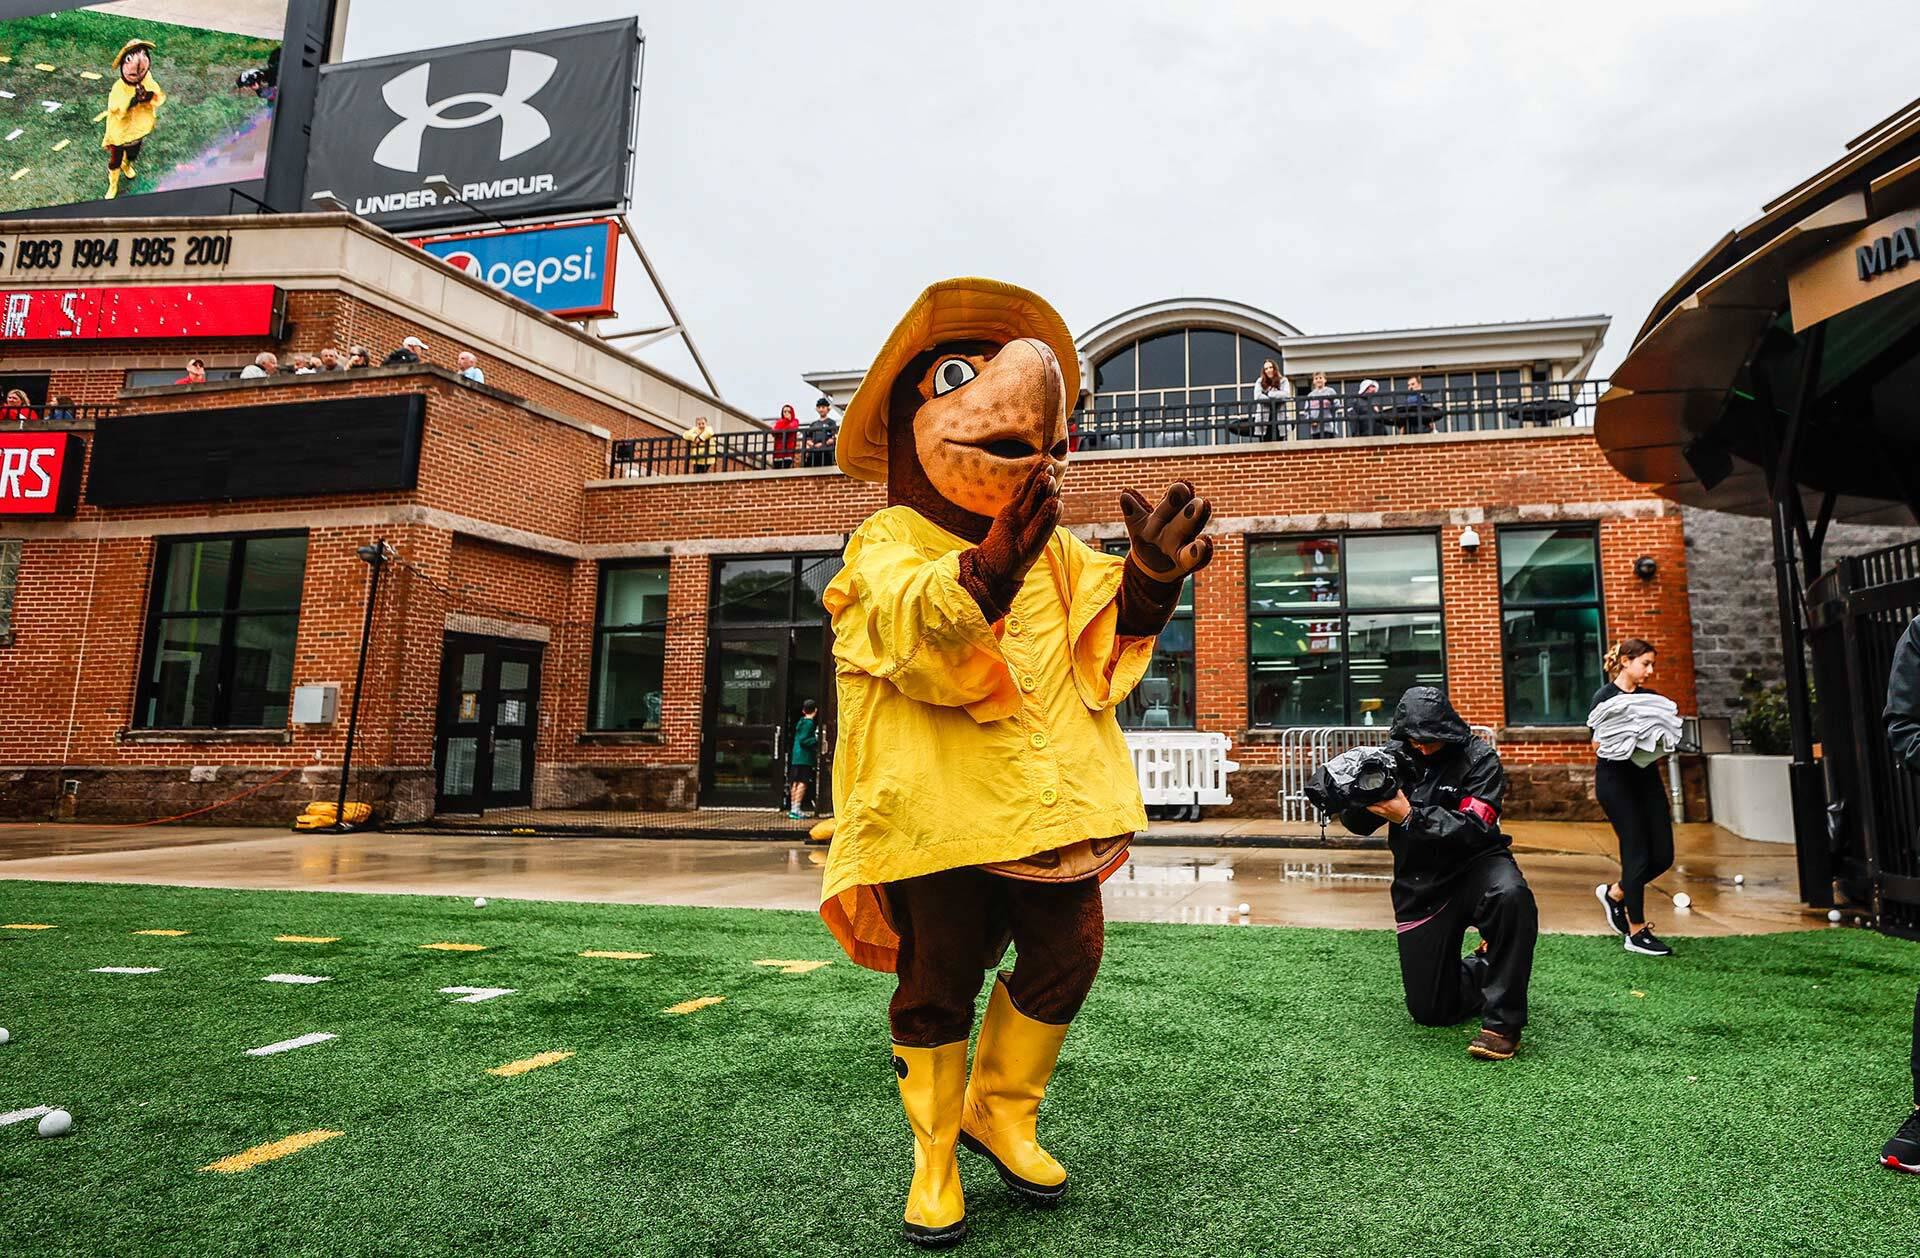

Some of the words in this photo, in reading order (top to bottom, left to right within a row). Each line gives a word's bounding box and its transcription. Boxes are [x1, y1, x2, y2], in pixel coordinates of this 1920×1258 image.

[355, 188, 436, 215] UNDER
[16, 239, 63, 269] 1983
[72, 238, 119, 268] 1984
[130, 237, 176, 266] 1985
[184, 236, 232, 266] 2001
[1856, 221, 1920, 281] MA
